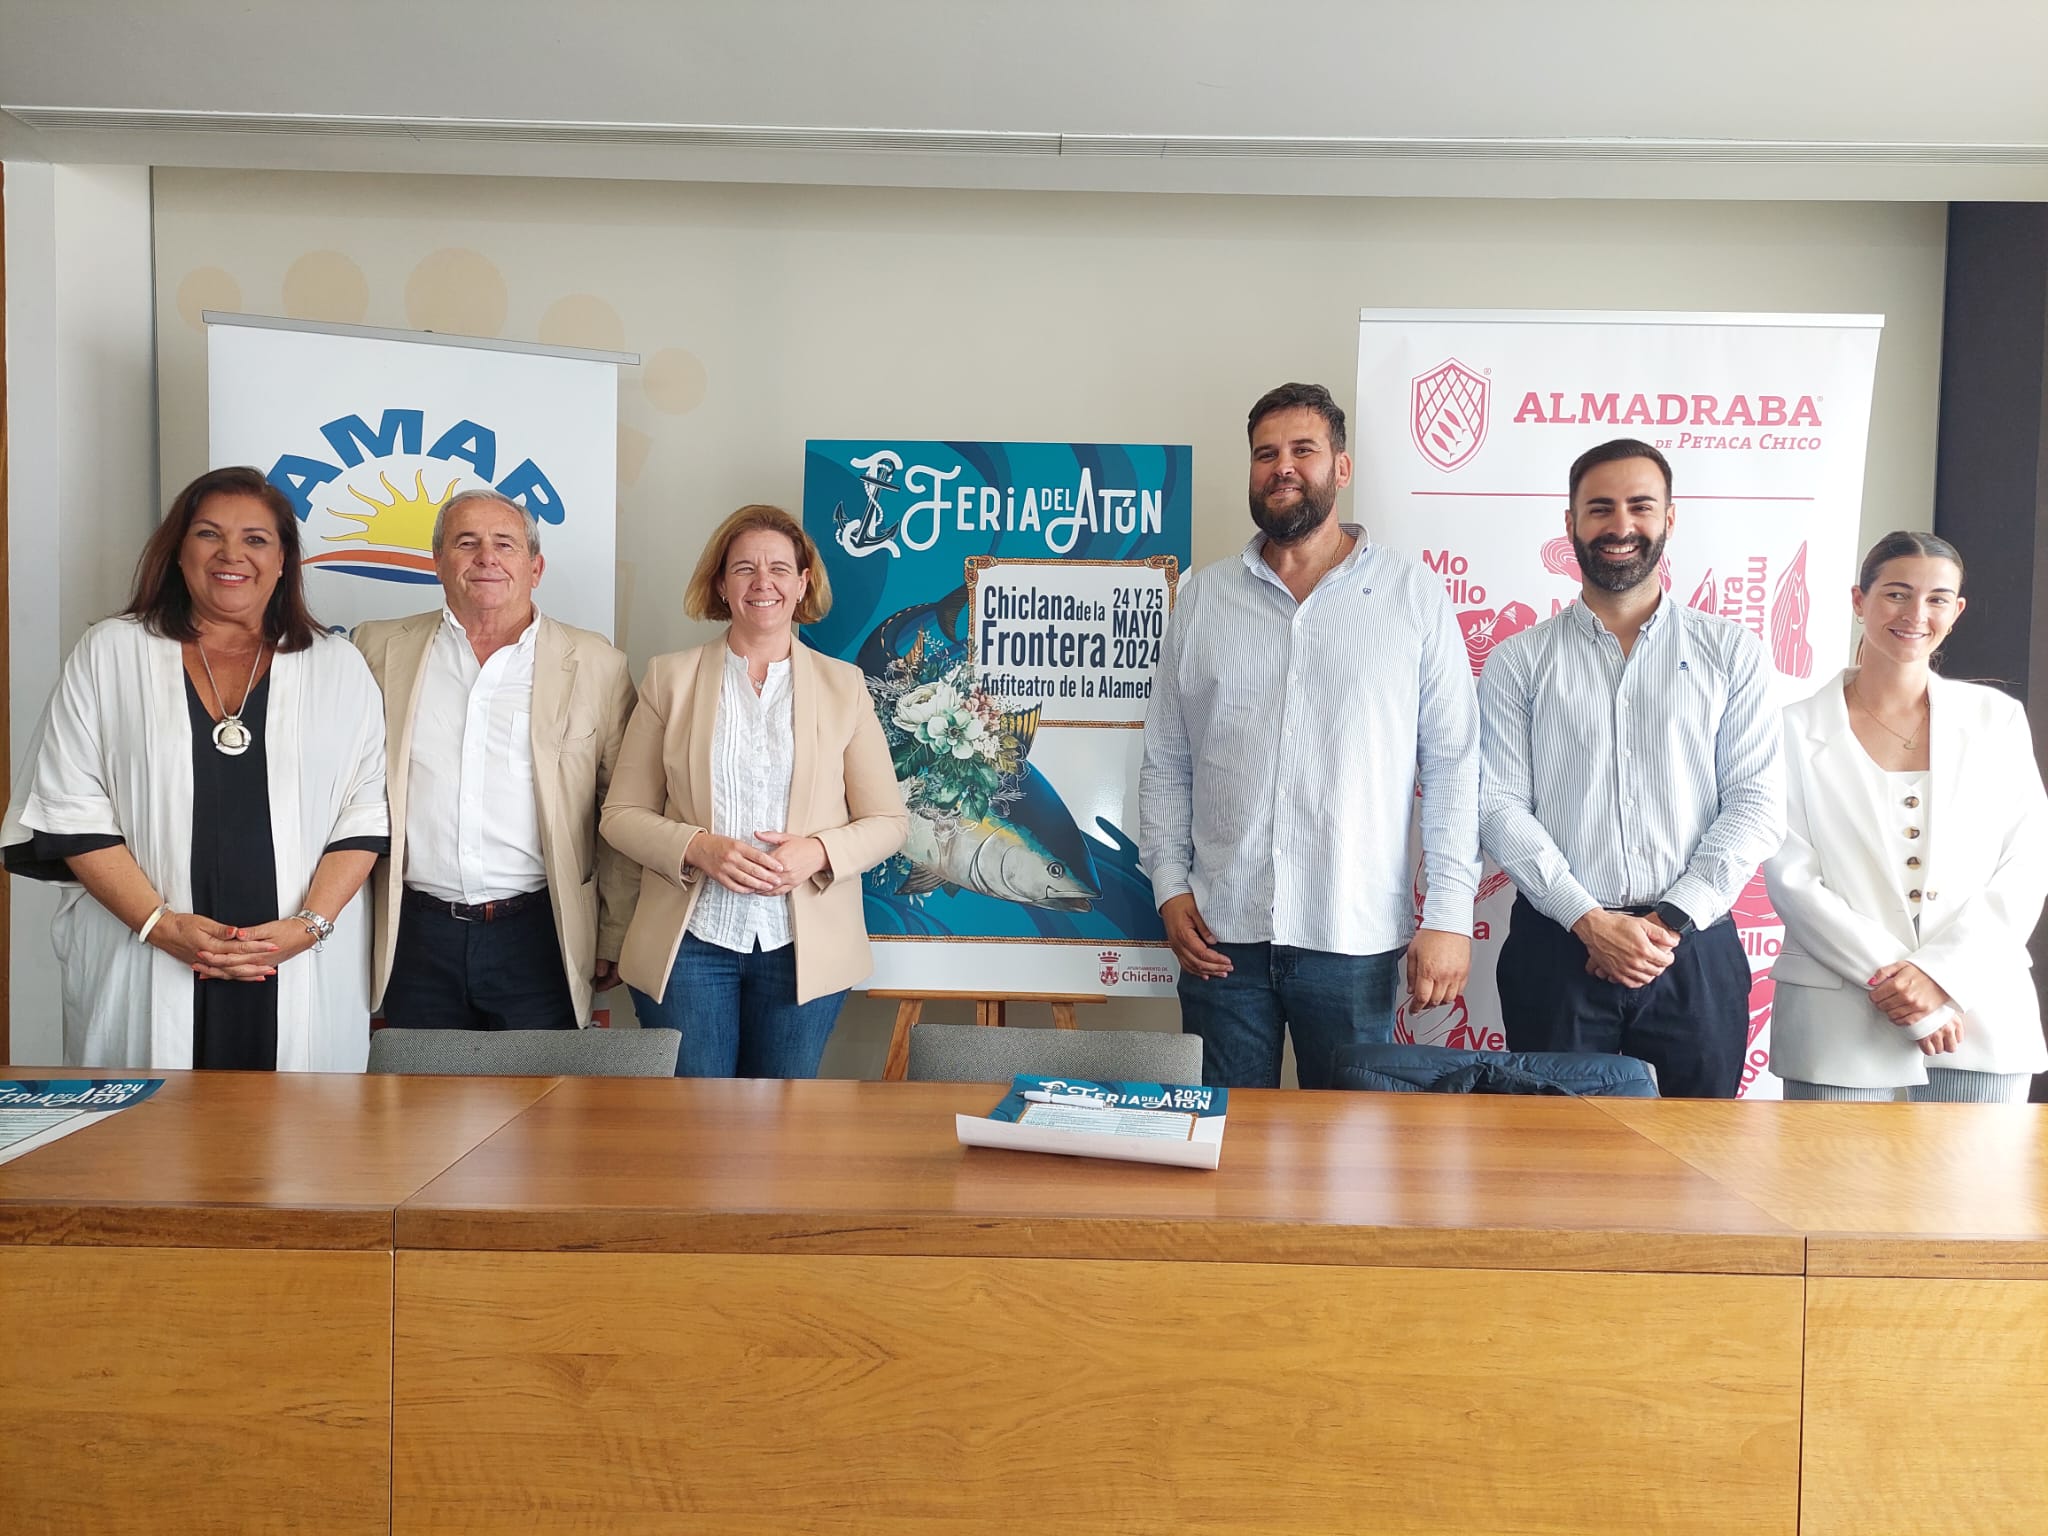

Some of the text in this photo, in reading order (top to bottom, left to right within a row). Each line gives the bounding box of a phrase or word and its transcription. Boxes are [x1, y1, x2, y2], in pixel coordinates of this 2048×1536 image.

[1513, 391, 1822, 426] ALMADRABA
[1655, 432, 1823, 450] DE PETACA CHICO
[1041, 488, 1075, 511] DEL
[1045, 467, 1162, 554] ATÚN
[983, 585, 1106, 621] Chiclana de la
[1113, 587, 1163, 610] 24 Y 25
[1445, 578, 1487, 605] illo
[1718, 576, 1744, 624] tra
[1112, 610, 1163, 639] MAYO
[981, 620, 1106, 668] Frontera
[1112, 638, 1161, 669] 2024
[981, 673, 1152, 699] Anfiteatro de la Alamed
[1740, 931, 1783, 957] illo
[1121, 970, 1174, 983] Chiclana
[97, 1083, 145, 1094] 2024
[1174, 1089, 1213, 1101] 2024
